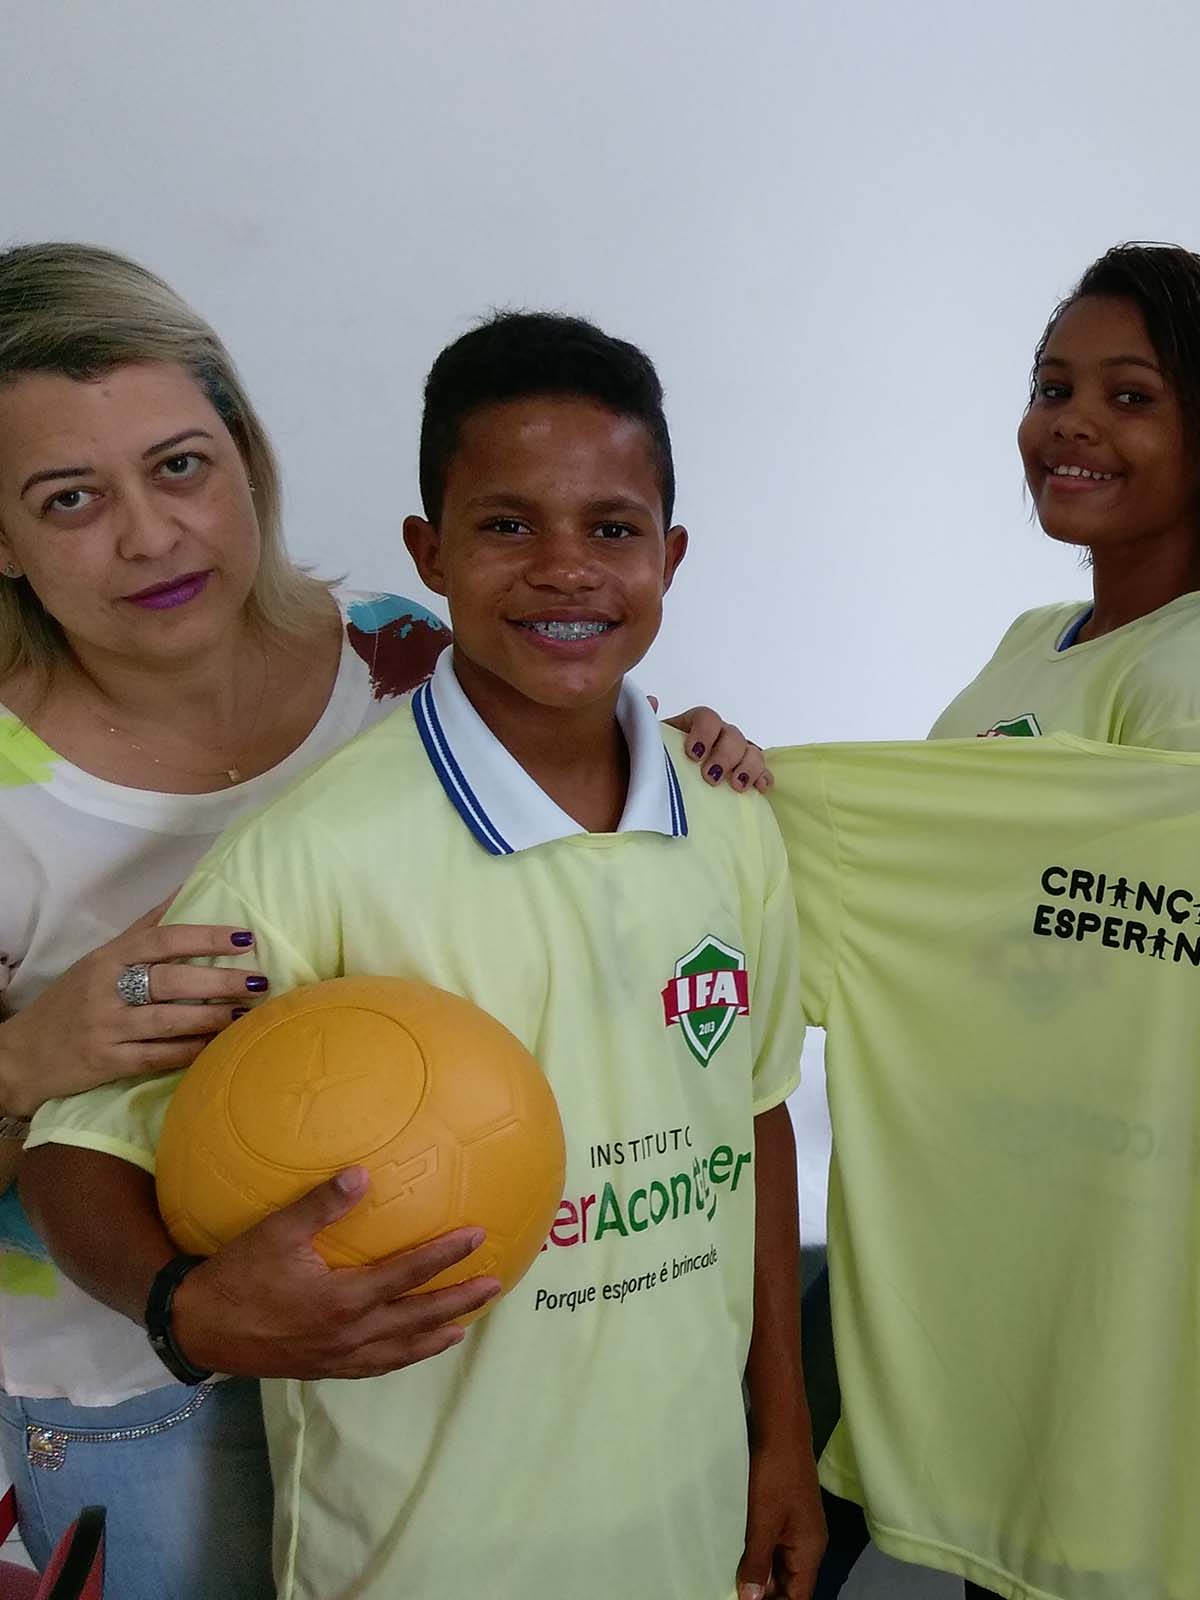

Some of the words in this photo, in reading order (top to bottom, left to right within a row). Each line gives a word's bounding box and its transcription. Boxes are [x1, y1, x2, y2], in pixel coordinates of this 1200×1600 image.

[676, 971, 740, 1013] IFA
[535, 1286, 596, 1312] Porque
[602, 1272, 657, 1304] esporte
[659, 1261, 668, 1283] é
